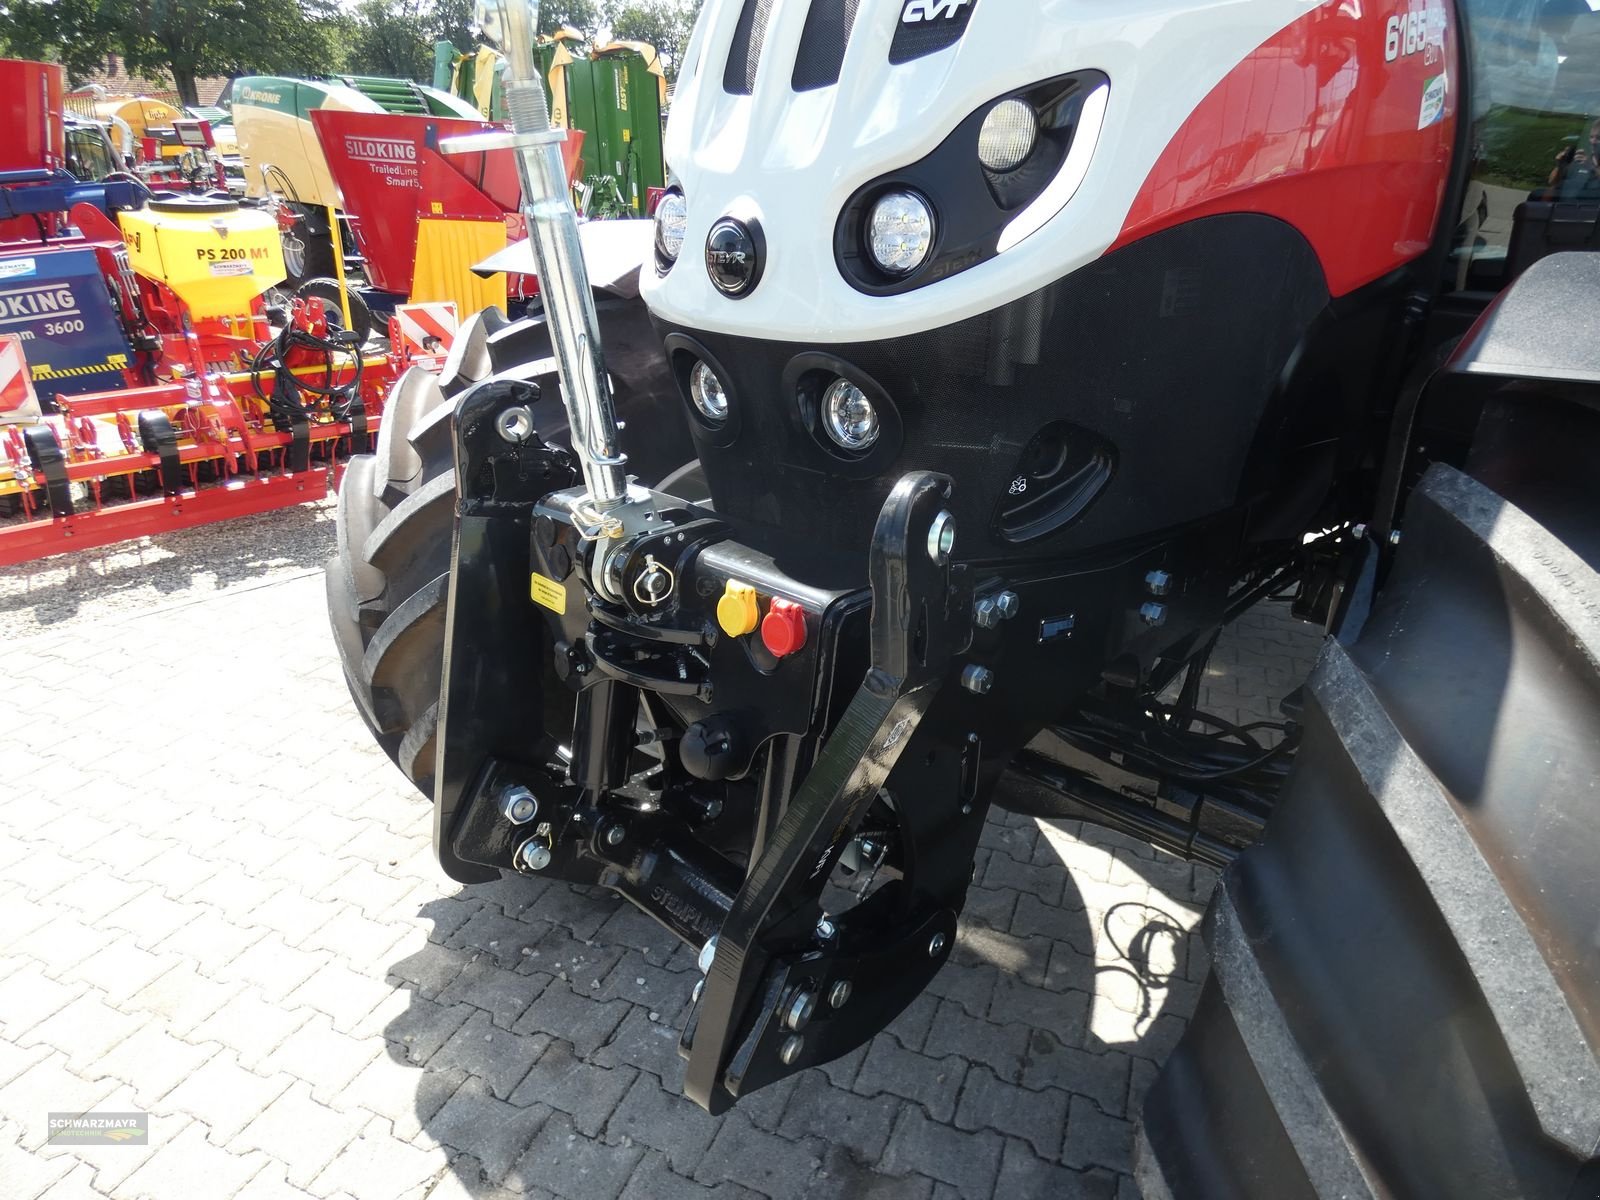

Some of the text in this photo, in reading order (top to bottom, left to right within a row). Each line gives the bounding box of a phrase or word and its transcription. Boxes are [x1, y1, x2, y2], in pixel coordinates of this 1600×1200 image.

[902, 0, 967, 23] CVT
[1385, 9, 1427, 62] 6165
[249, 90, 281, 105] KRONE
[345, 140, 416, 160] SILOKING
[197, 247, 270, 260] PS 200 M1
[707, 251, 746, 264] STEYR
[44, 319, 85, 336] 3600
